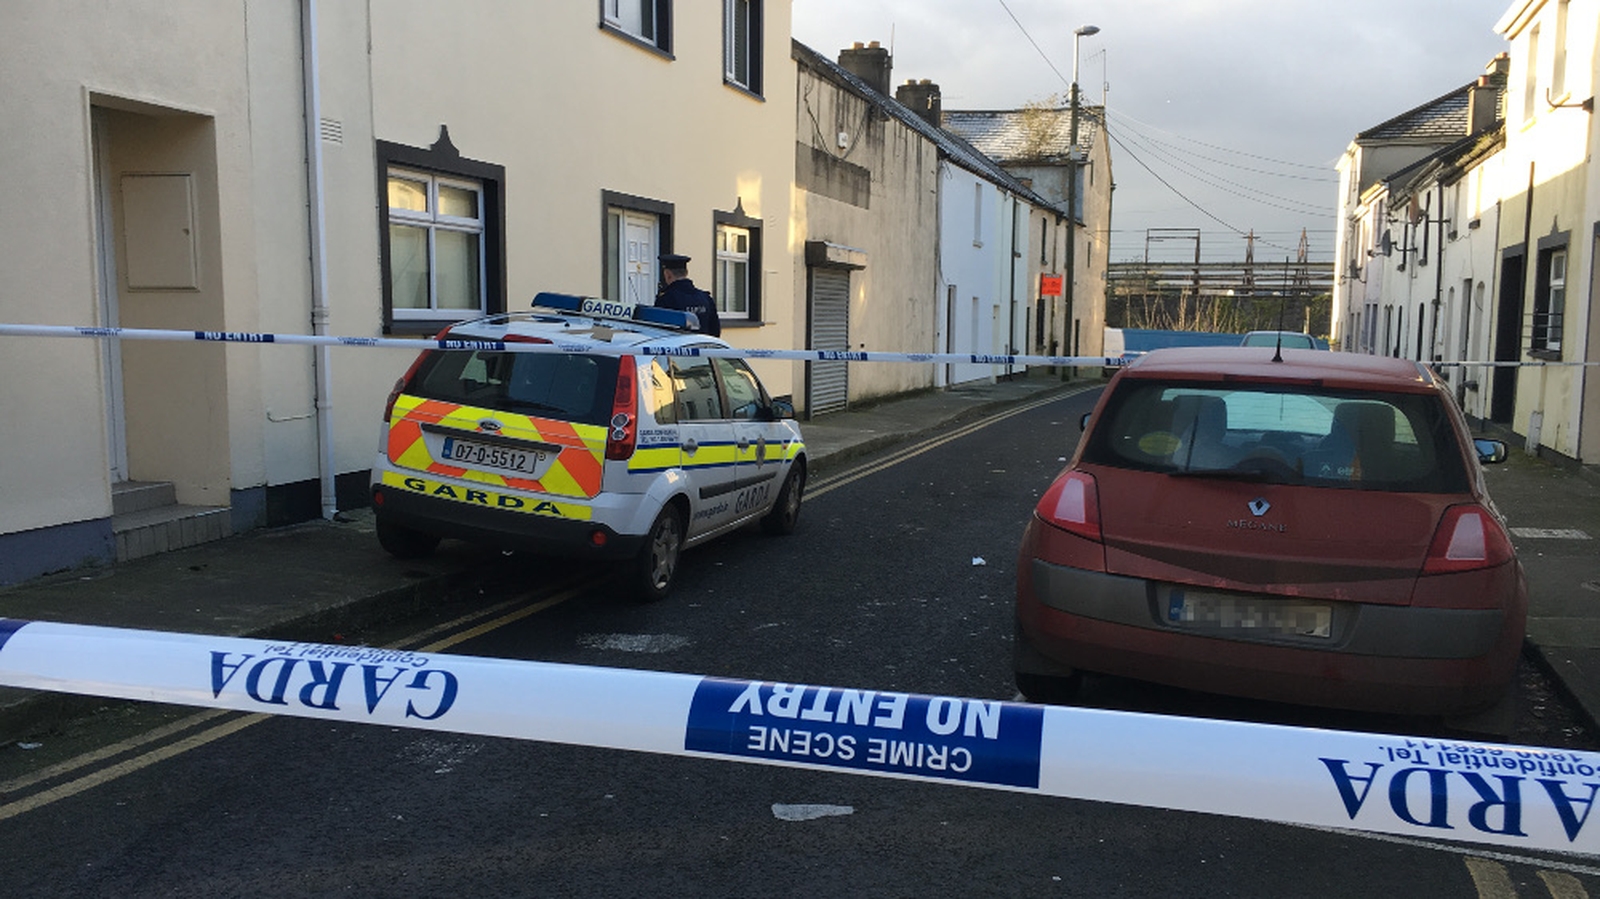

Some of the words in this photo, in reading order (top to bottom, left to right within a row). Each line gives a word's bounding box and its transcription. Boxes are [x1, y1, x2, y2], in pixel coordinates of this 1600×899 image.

[583, 300, 632, 318] GARDA
[455, 444, 526, 470] 07-D-5512
[404, 477, 563, 516] GARDA
[298, 645, 430, 668] Confidential
[209, 650, 459, 721] GARDA
[728, 680, 910, 730] ENTRY
[925, 695, 1003, 740] NO
[747, 725, 858, 760] SCENE
[867, 738, 974, 773] CRIME
[1378, 745, 1430, 765] Tel.
[1438, 749, 1600, 778] onfidential
